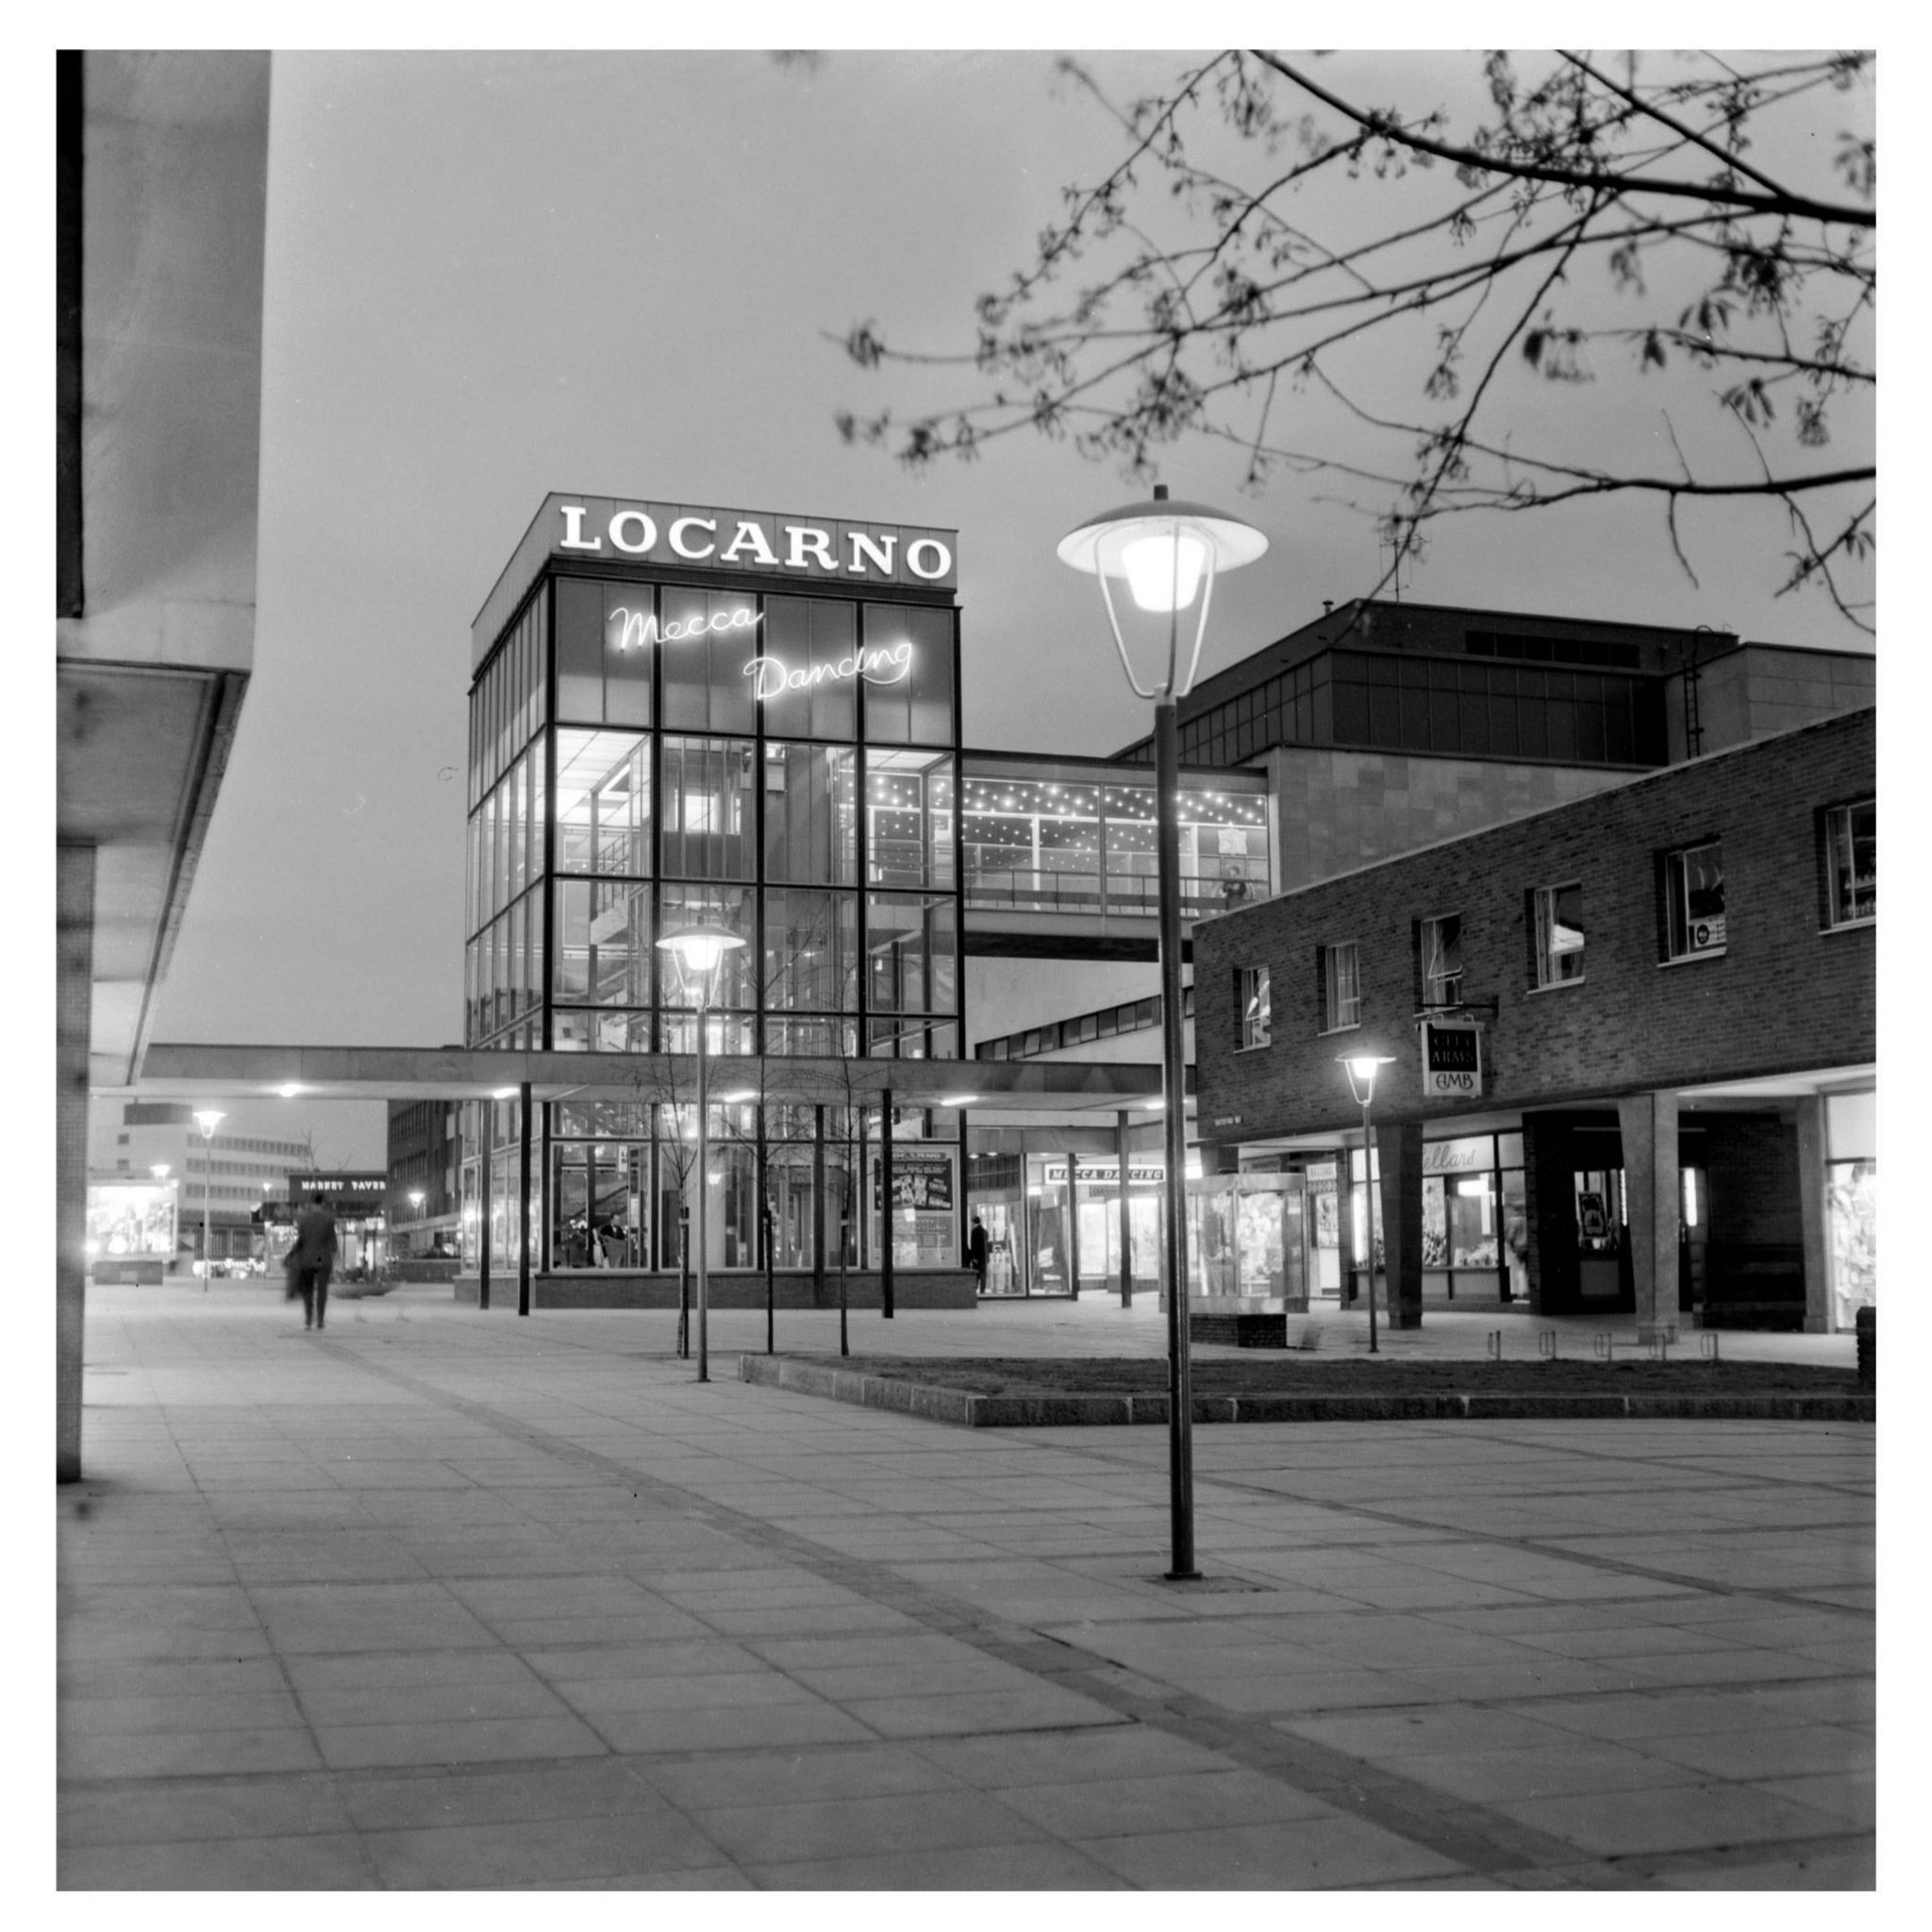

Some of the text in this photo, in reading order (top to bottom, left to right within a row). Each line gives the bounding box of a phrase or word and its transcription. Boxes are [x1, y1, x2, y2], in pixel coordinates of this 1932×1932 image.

[559, 506, 952, 580] LOCARNO
[608, 607, 764, 652] Mecca
[743, 641, 913, 701] Dancing
[1433, 1034, 1471, 1048] CITY
[1431, 1050, 1474, 1064] ARMS
[1423, 1143, 1476, 1171] ellard
[1103, 1170, 1162, 1180] DACING
